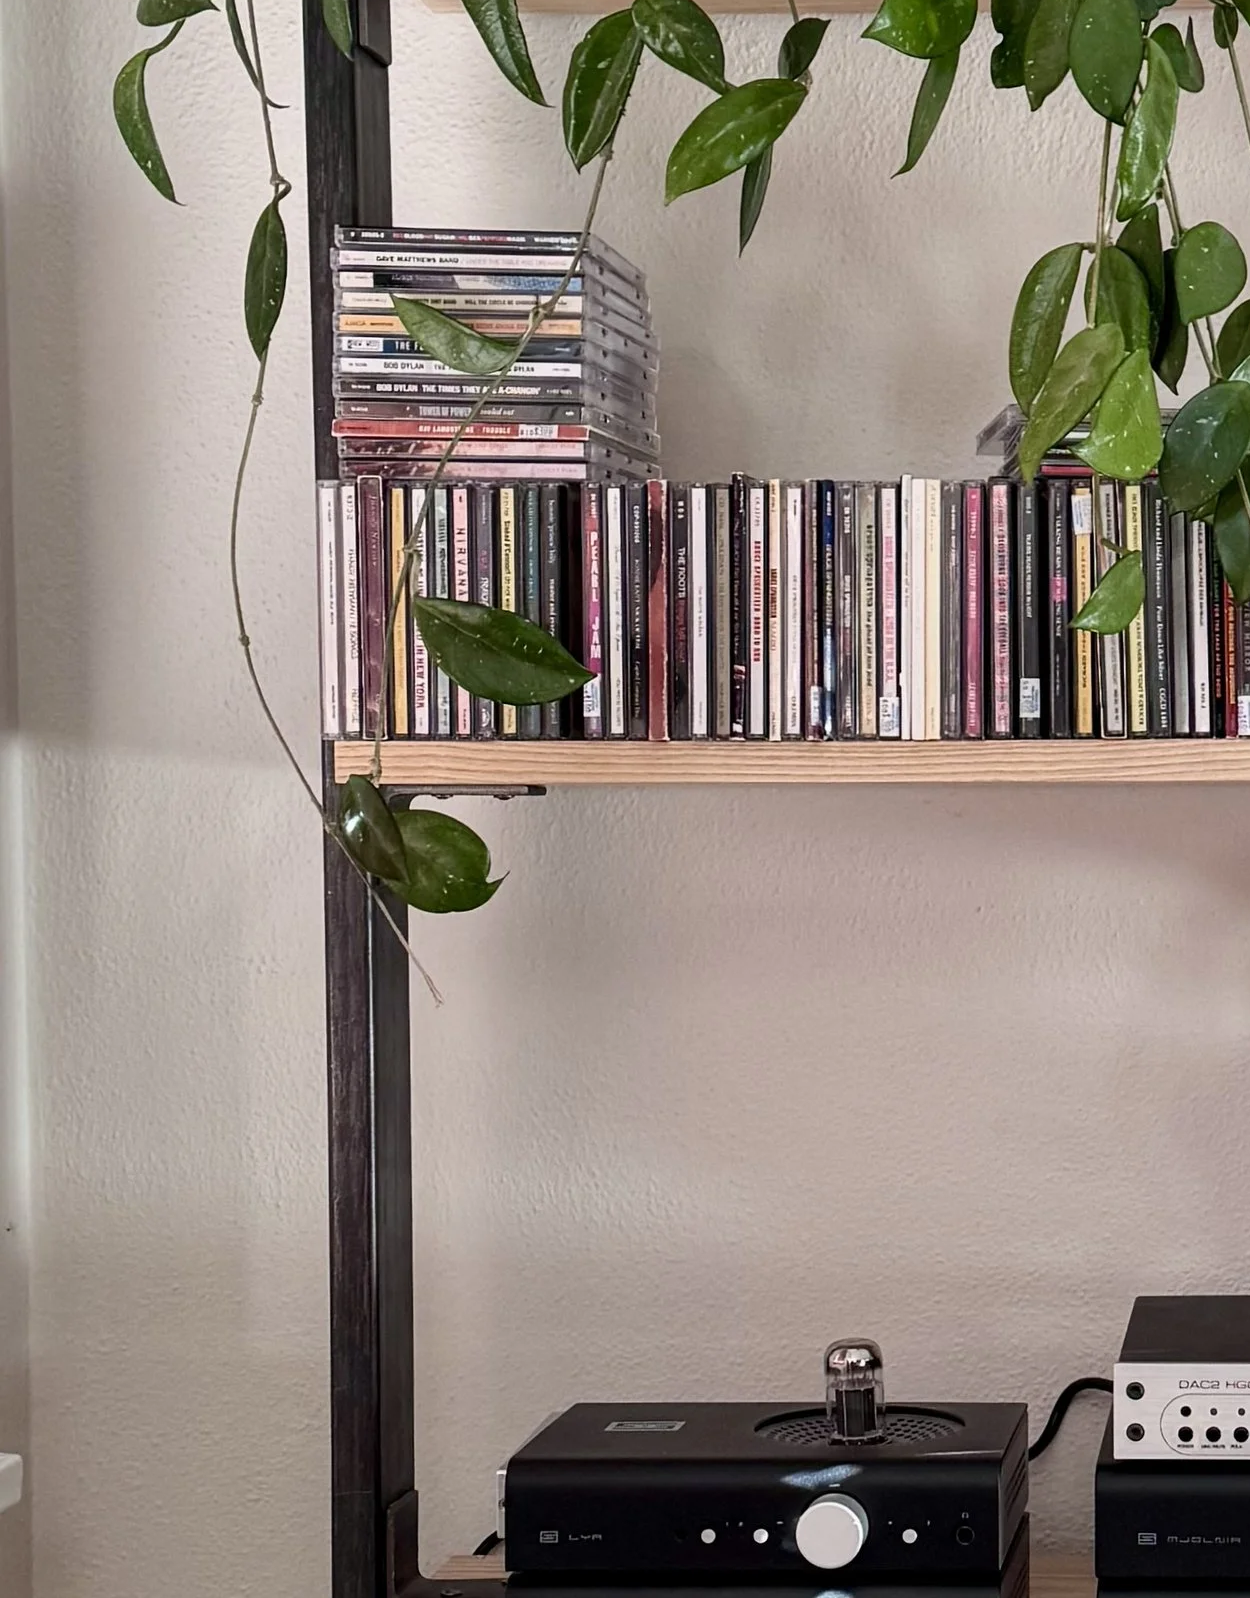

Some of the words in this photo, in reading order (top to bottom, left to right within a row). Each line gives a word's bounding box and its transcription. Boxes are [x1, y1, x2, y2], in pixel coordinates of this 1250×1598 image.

[400, 362, 424, 370] DYLAN
[394, 384, 418, 392] DYLAN
[422, 384, 436, 392] THE
[438, 385, 460, 393] TIMES
[462, 385, 480, 393] THEY
[456, 527, 467, 597] NIRVANA
[590, 531, 600, 602] PEARL
[677, 547, 686, 565] THE
[678, 567, 686, 599] ROOTS
[590, 616, 601, 659] JAM
[416, 658, 424, 679] NEW
[416, 683, 425, 709] YORK
[1179, 1380, 1220, 1389] DAC2
